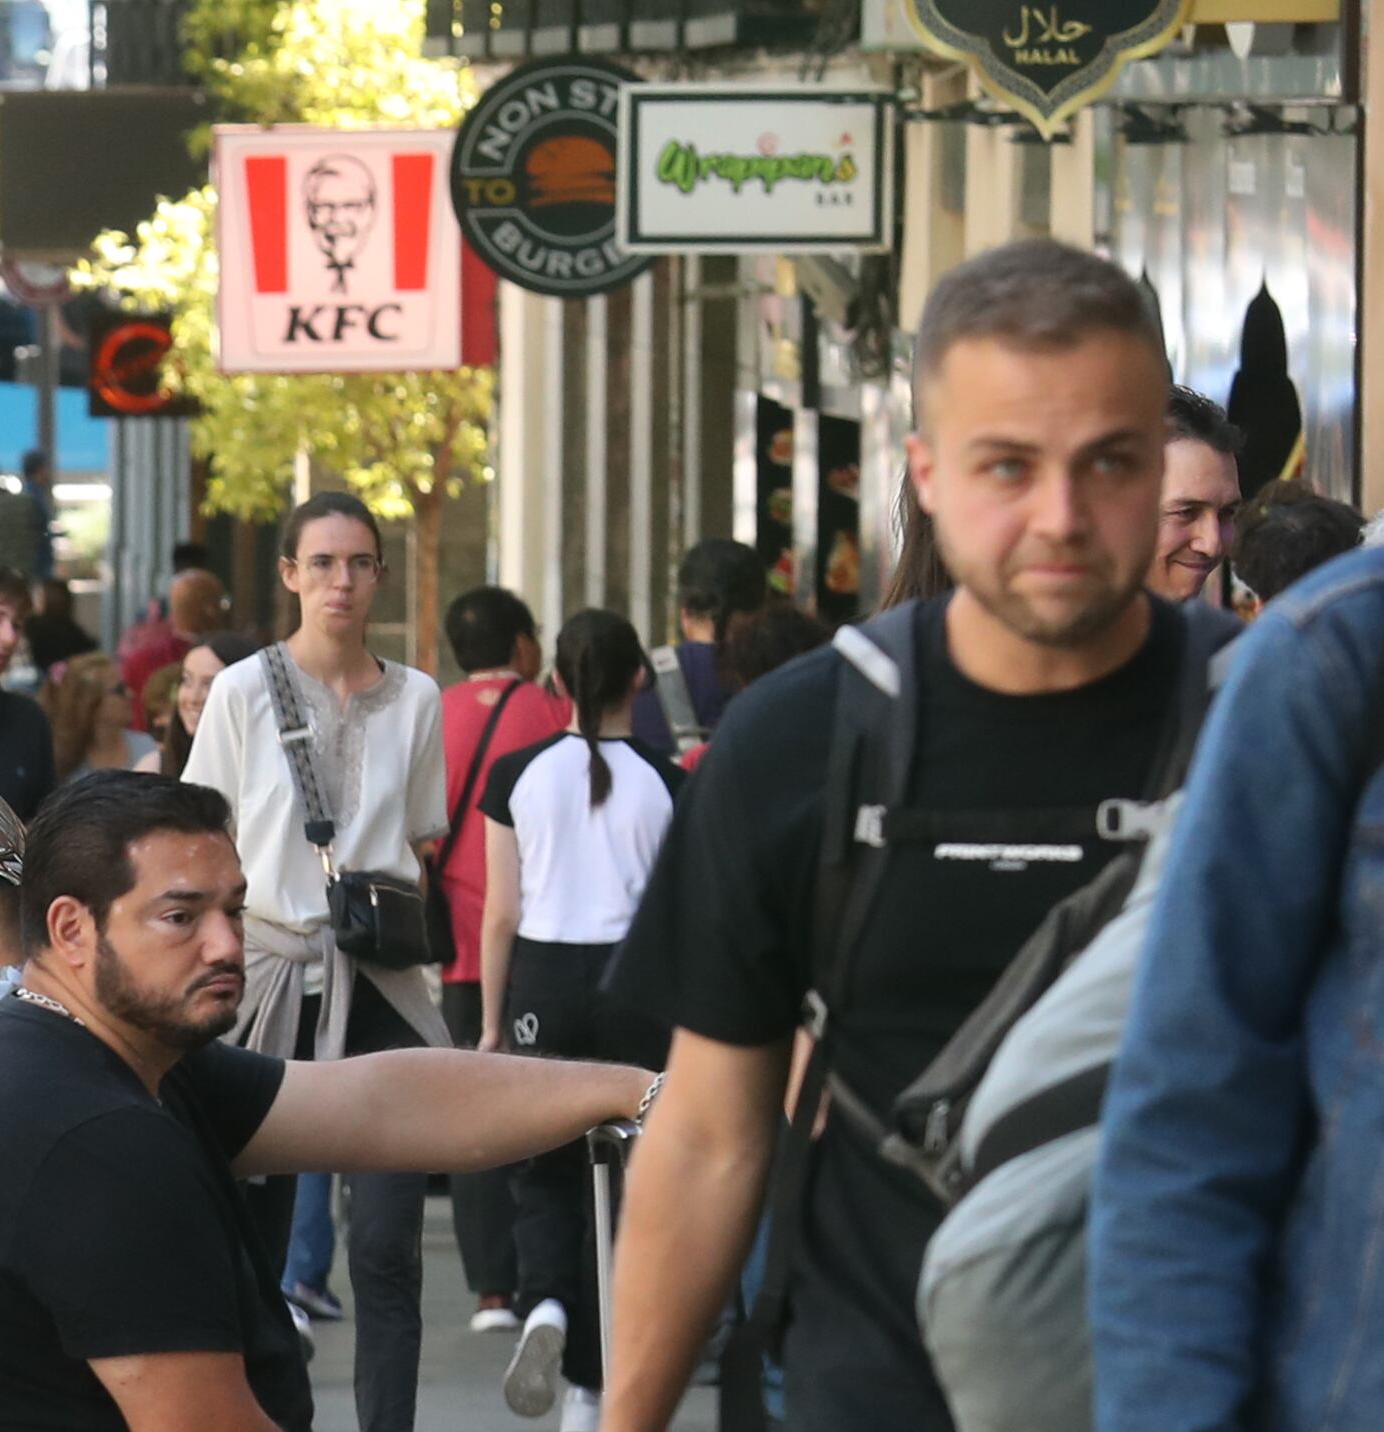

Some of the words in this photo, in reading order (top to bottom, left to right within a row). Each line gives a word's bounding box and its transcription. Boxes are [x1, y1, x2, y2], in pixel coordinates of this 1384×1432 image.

[1002, 4, 1093, 48] حلال
[1014, 48, 1082, 65] HALAL
[477, 80, 561, 162] NON
[568, 77, 618, 116] ST
[281, 302, 404, 343] KFC
